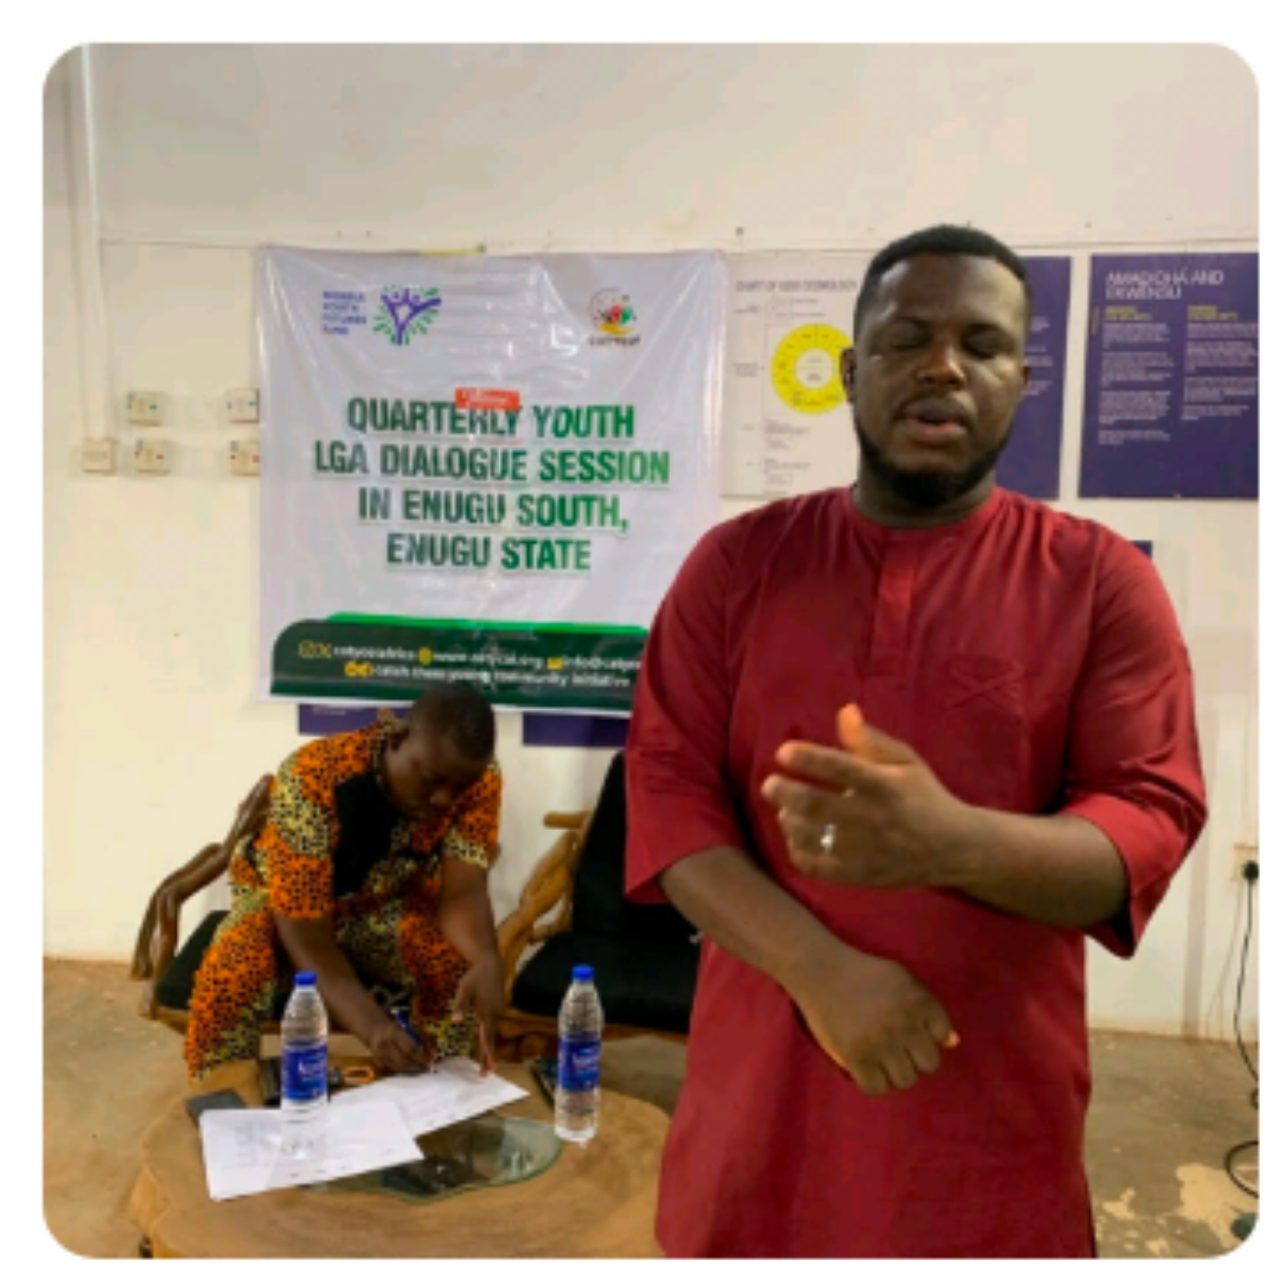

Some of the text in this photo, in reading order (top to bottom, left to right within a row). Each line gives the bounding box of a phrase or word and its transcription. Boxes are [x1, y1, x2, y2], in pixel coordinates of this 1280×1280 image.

[348, 398, 522, 438] QUARTERLY
[532, 404, 635, 440] YOUTH
[314, 441, 671, 484] LGA DIALOGUE SESSION
[358, 487, 629, 532] IN ENUGU SOUTH,
[387, 532, 591, 570] ENUGU STATE
